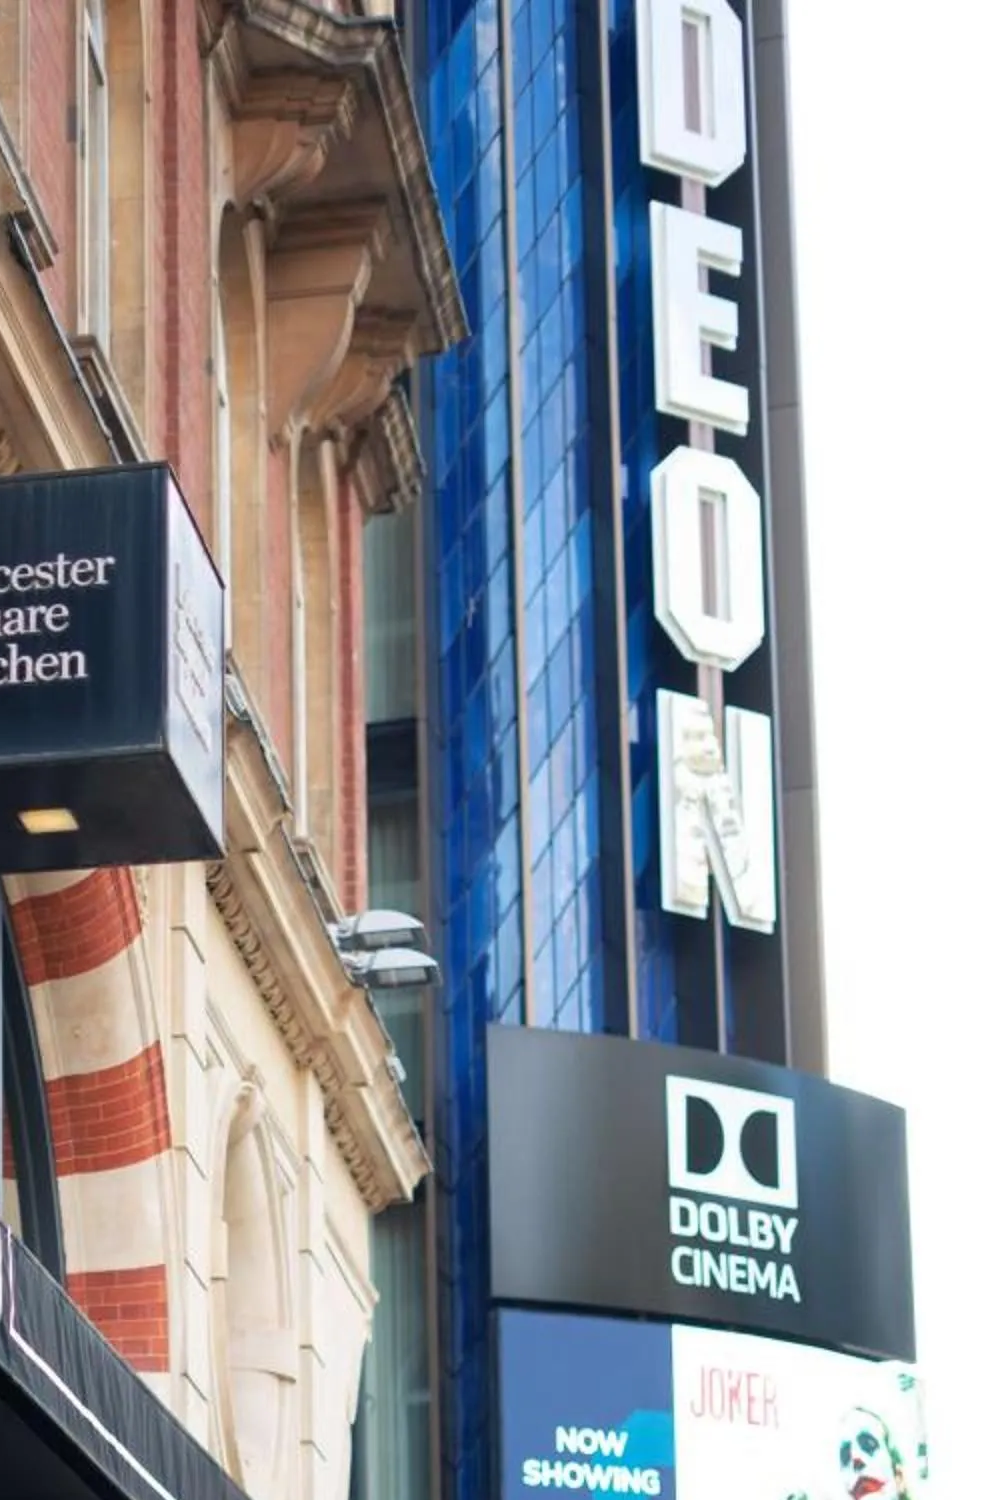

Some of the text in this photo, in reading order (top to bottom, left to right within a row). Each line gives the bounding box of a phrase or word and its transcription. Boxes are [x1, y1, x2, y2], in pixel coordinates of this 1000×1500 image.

[669, 1196, 798, 1256] DOLBY
[671, 1245, 801, 1304] CINEMA
[690, 1364, 779, 1430] JOKER
[554, 1424, 629, 1459] NOW
[522, 1459, 661, 1497] SHOWING
